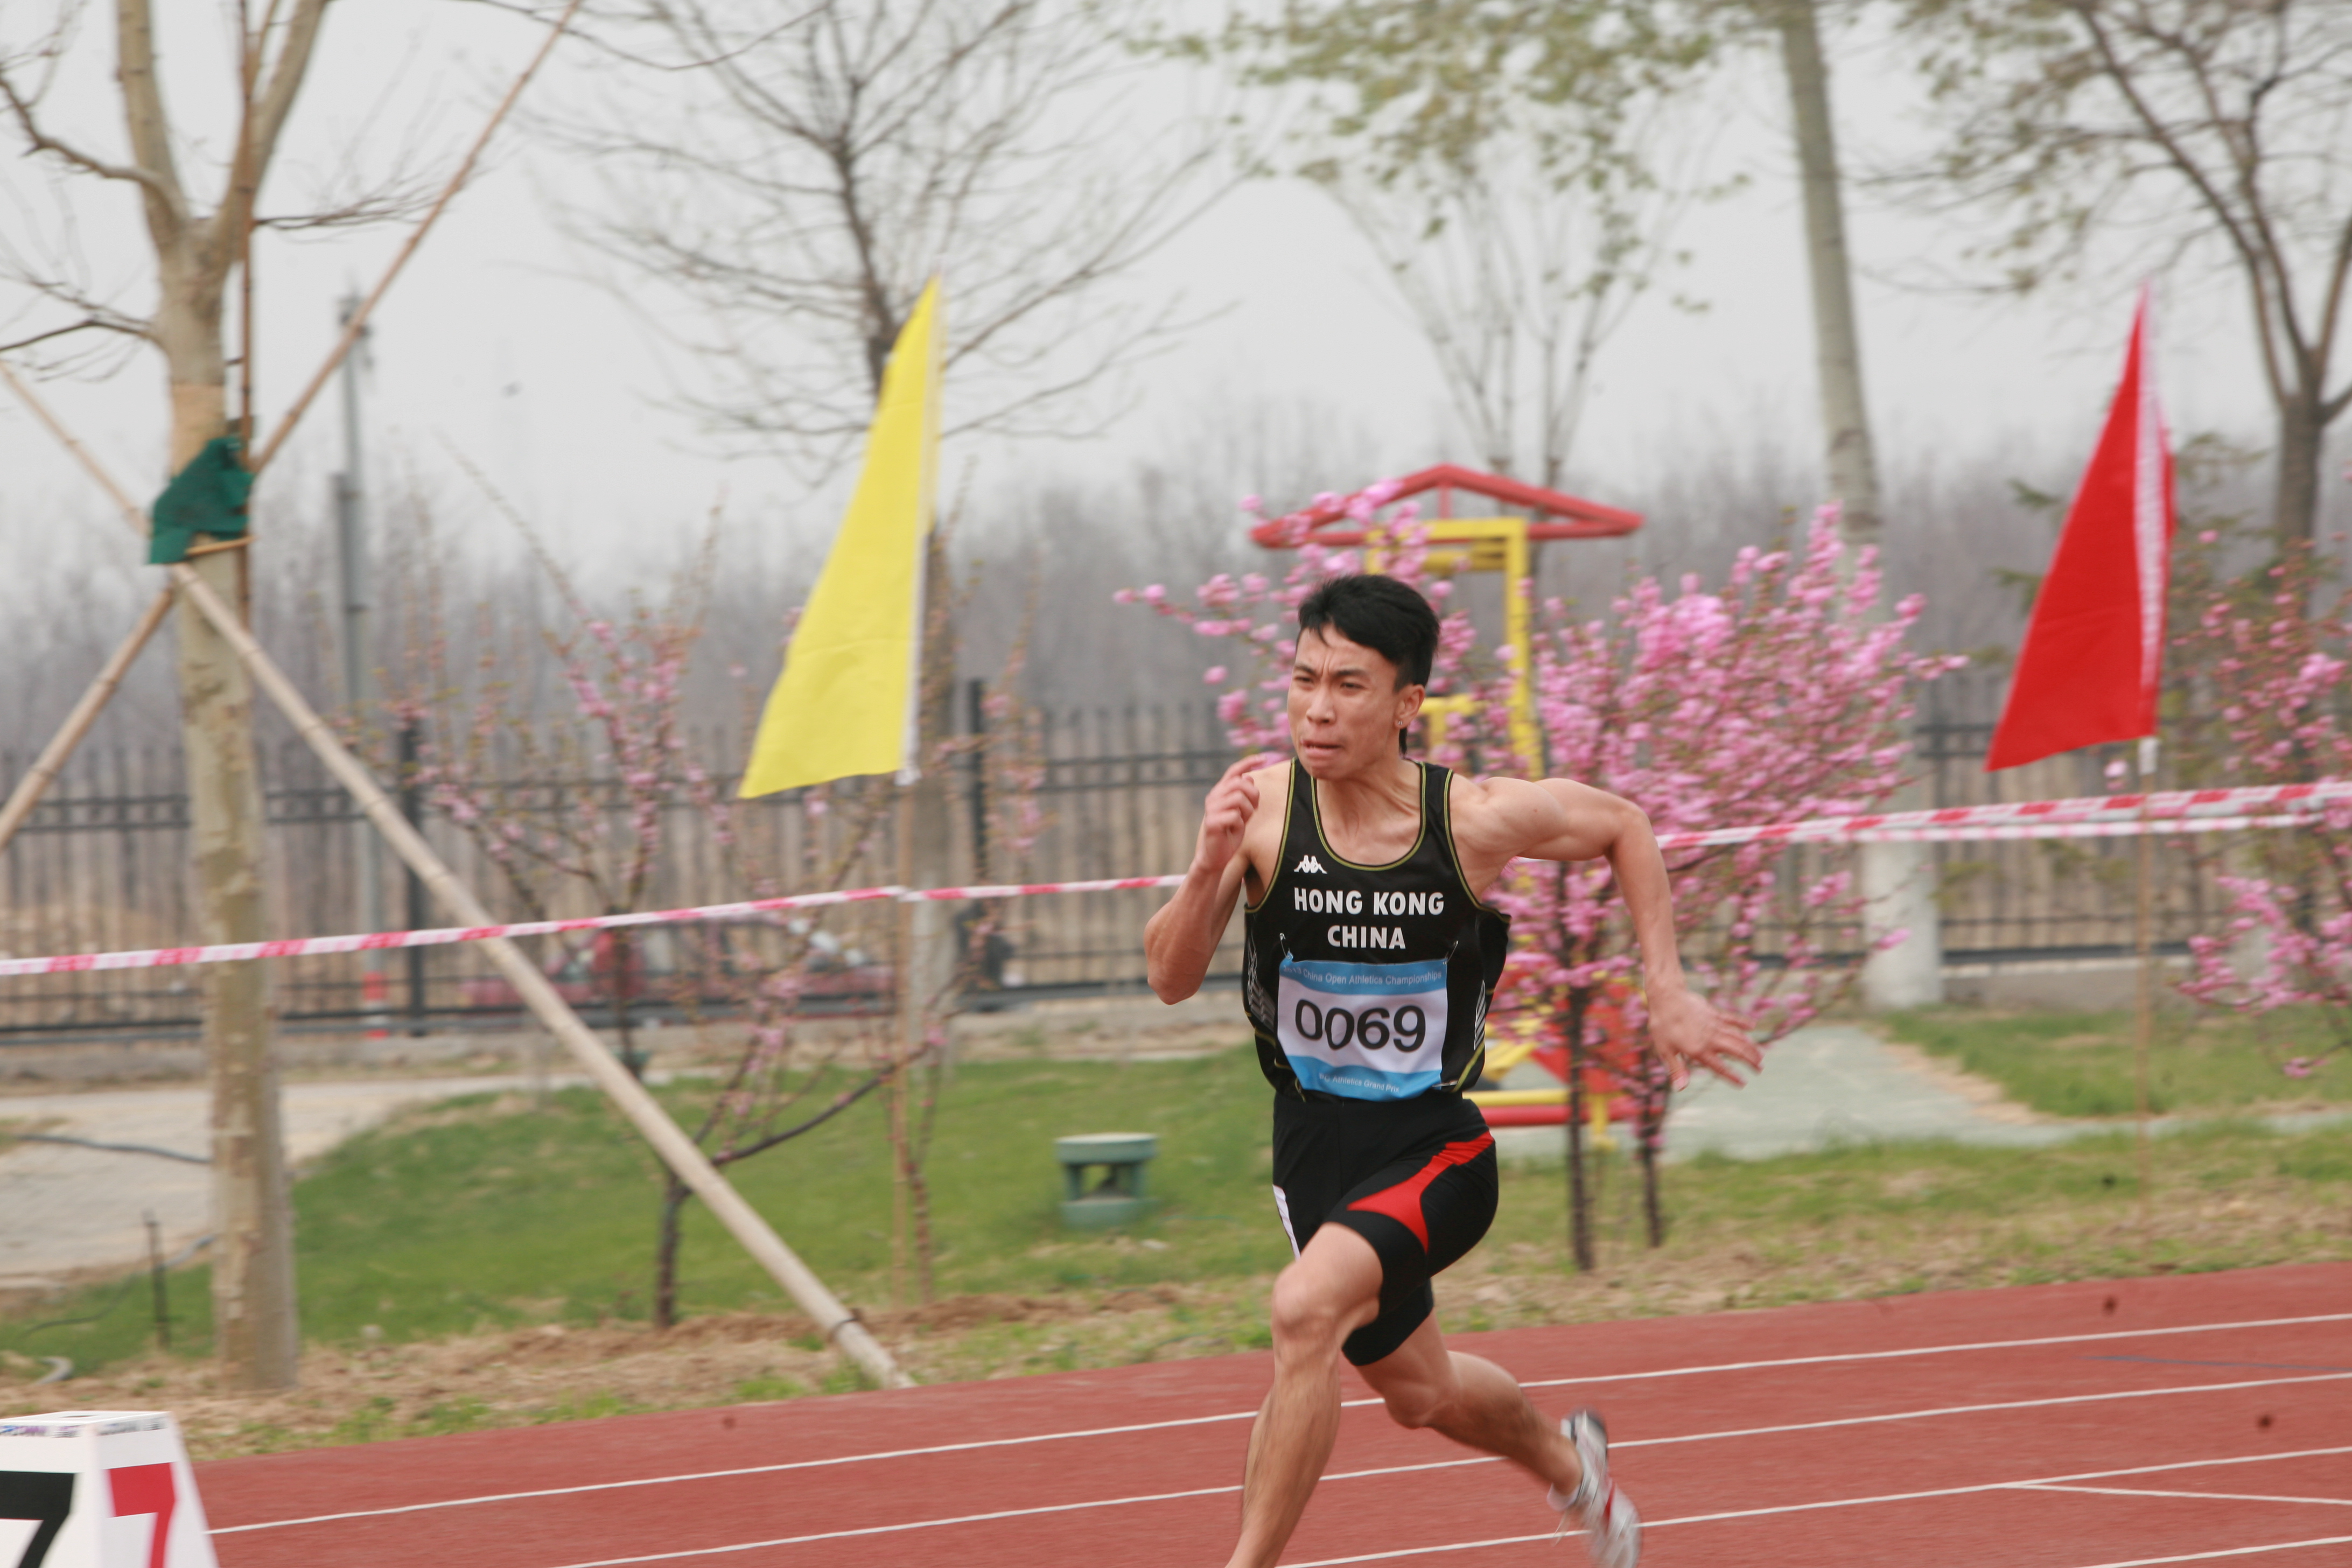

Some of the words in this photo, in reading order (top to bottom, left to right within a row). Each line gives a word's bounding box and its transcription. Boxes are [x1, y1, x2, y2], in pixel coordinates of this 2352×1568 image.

[1294, 887, 1363, 914] HONG
[1374, 892, 1444, 915] KONG
[1327, 925, 1406, 949] CHINA
[1303, 969, 1322, 982] China
[1325, 972, 1346, 985] Open
[1349, 975, 1383, 985] Athletics
[1385, 971, 1442, 986] Championships
[1295, 999, 1426, 1052] 0069
[1333, 1076, 1362, 1086] Athletics
[1364, 1079, 1385, 1090] Grand
[1386, 1084, 1399, 1093] Prix
[0, 1471, 80, 1568] 7
[103, 1461, 177, 1568] 7
